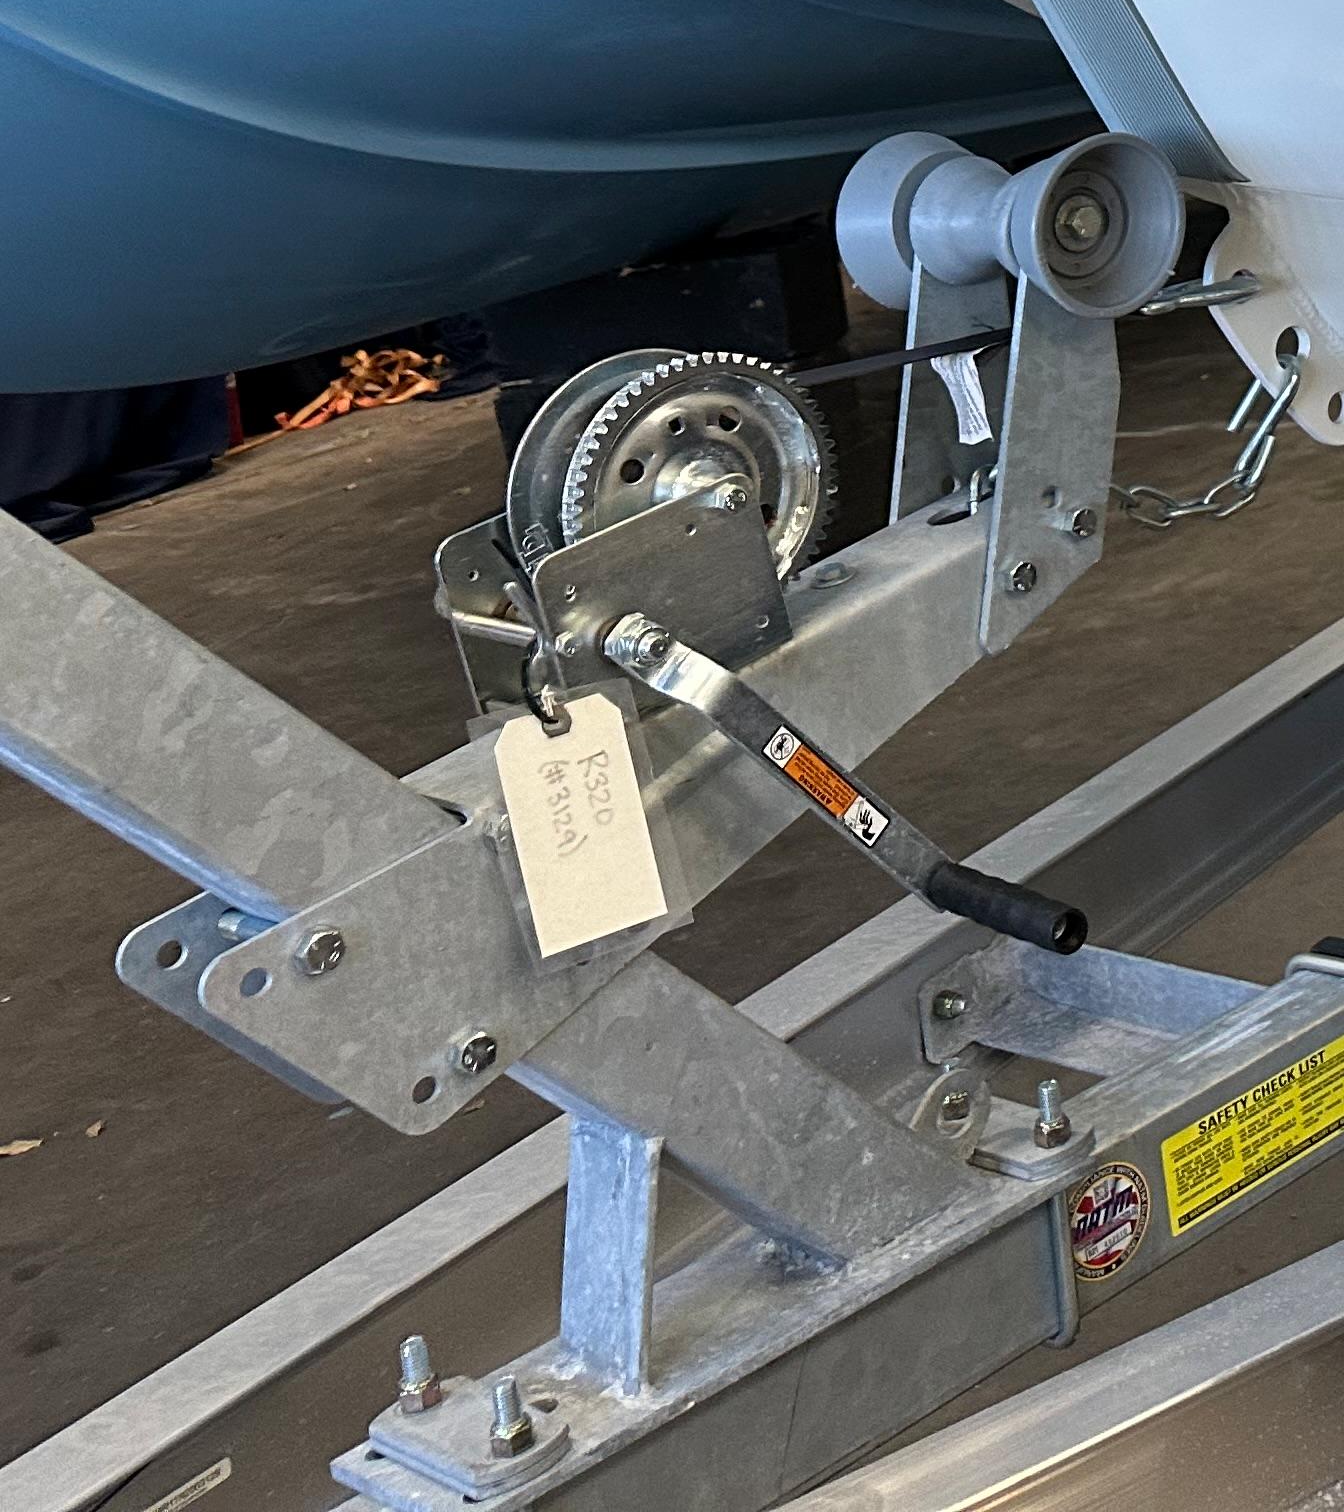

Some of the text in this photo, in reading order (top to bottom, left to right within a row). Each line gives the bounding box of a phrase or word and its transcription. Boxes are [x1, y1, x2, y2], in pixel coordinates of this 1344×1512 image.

[577, 749, 616, 827] R320
[1198, 1050, 1327, 1136] SAFETY CHECK LIST
